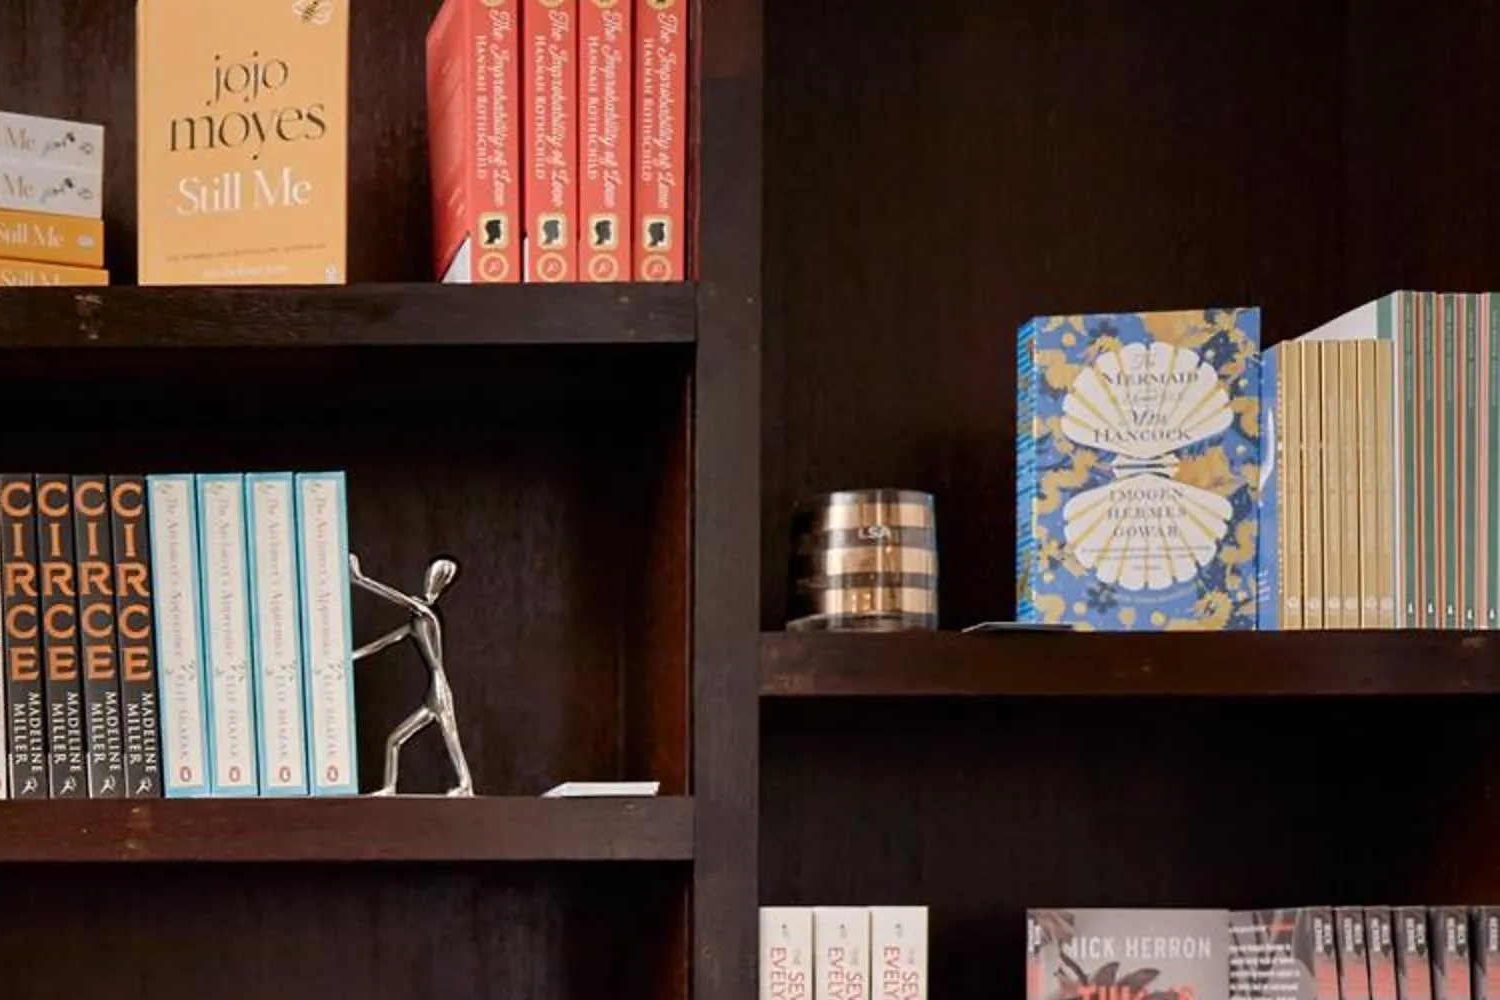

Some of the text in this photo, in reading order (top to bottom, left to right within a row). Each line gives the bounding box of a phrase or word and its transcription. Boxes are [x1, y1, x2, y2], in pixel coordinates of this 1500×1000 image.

[205, 50, 289, 106] jojo
[2, 128, 36, 152] Me
[170, 103, 327, 161] moyes
[0, 175, 34, 198] Me
[176, 166, 312, 215] Still Me
[33, 226, 65, 248] Me
[1094, 429, 1191, 443] HANCOCK
[1109, 487, 1184, 501] IMOGEN
[2, 482, 39, 681] CIRCE
[37, 482, 76, 681] CIRCE
[73, 482, 116, 681] CIRCE
[111, 482, 150, 681] CIRCE
[13, 703, 27, 765] MILLER
[29, 691, 43, 772] MADELINE
[52, 703, 66, 765] MILLER
[67, 691, 81, 772] MADELINE
[91, 702, 105, 764] MILLER
[105, 691, 119, 772] MADELINE
[127, 703, 142, 765] MILLER
[142, 691, 157, 772] MADELINE
[1126, 937, 1212, 959] HERRON
